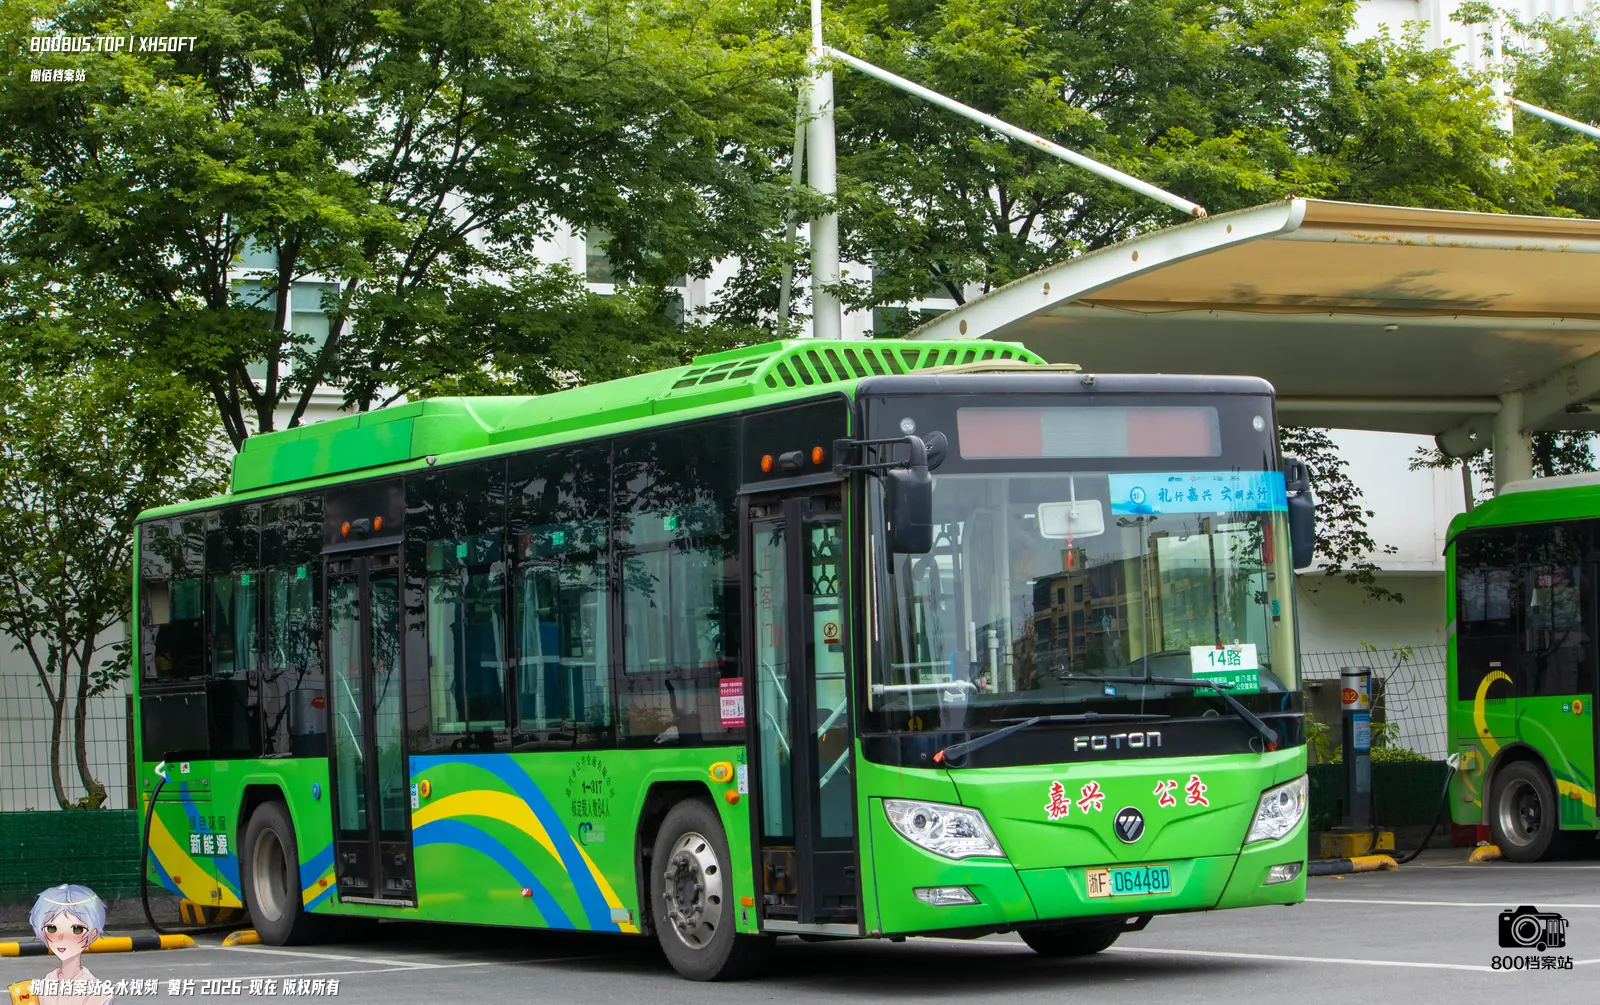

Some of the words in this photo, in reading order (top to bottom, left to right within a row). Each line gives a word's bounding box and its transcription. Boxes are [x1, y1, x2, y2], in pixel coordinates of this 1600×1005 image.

[1208, 650, 1241, 666] 14路
[1073, 731, 1162, 751] FOTON
[582, 780, 603, 794] 1-317
[1044, 781, 1105, 820] 嘉兴
[1153, 774, 1210, 807] 公交
[189, 833, 229, 855] 新能源
[1114, 868, 1169, 892] 06448D
